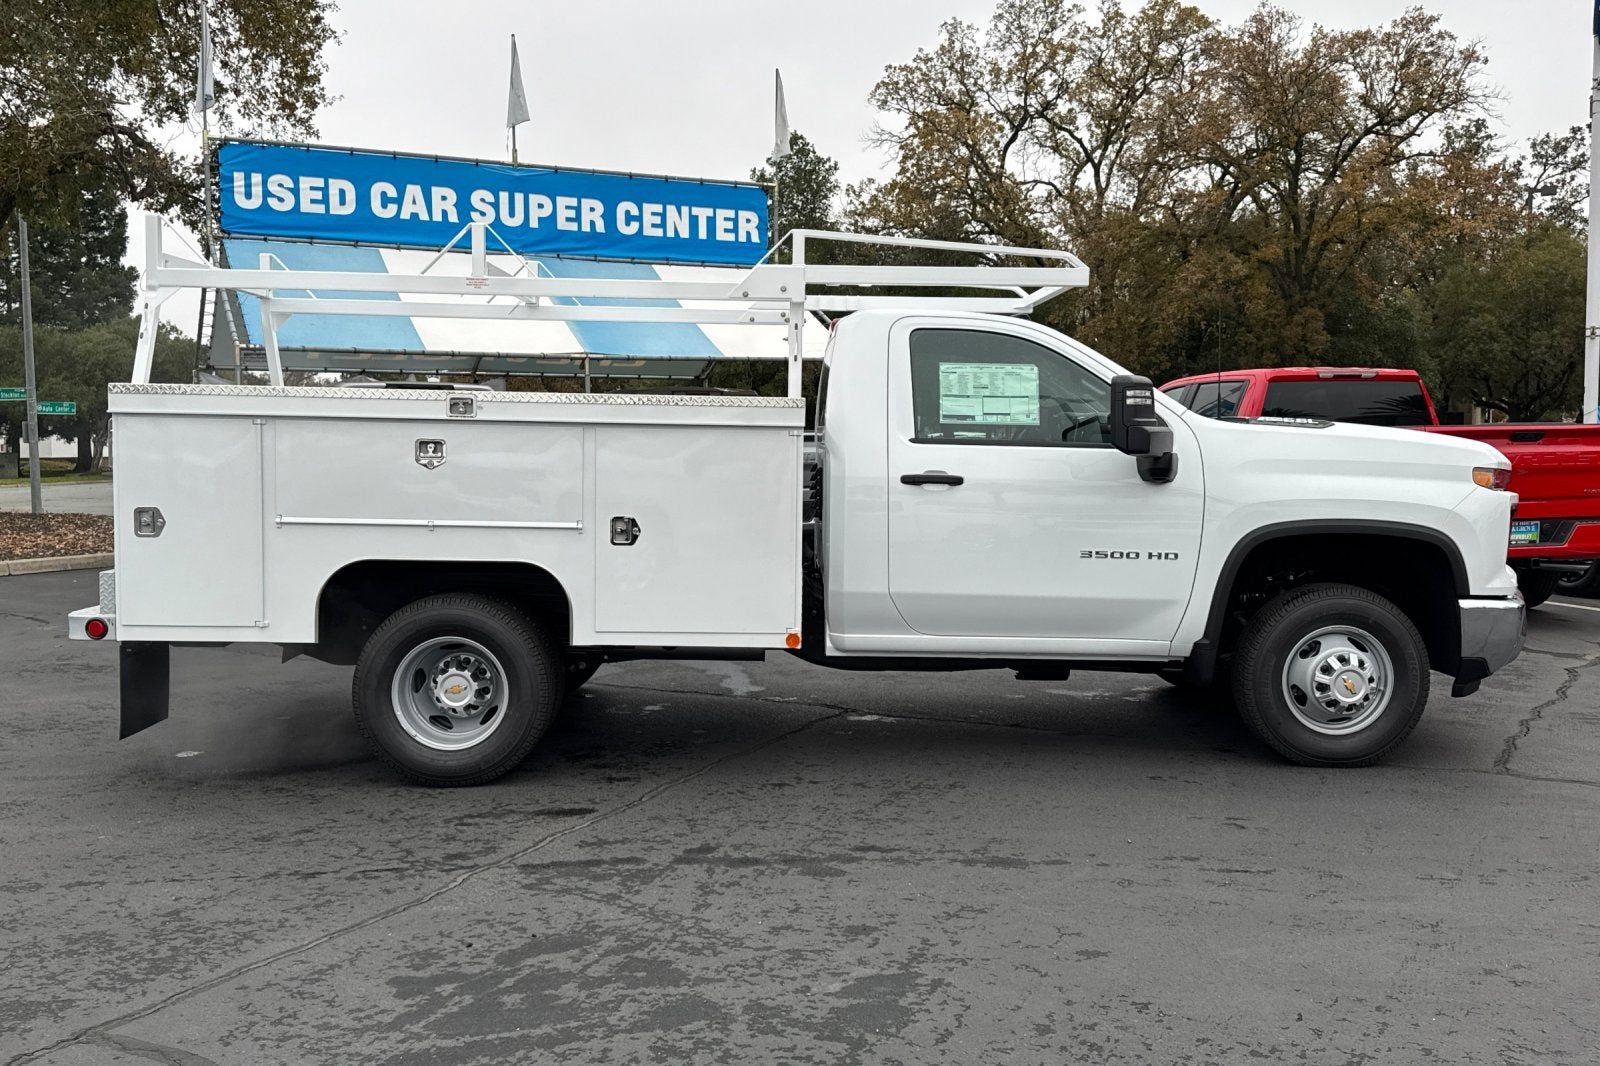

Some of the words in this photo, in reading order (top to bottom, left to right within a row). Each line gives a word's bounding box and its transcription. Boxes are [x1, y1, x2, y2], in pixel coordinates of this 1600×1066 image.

[233, 171, 356, 216] USED
[370, 181, 460, 224] CAR
[470, 189, 606, 233] SUPER
[616, 201, 761, 243] CENTER
[1079, 550, 1140, 560] 3500
[1147, 551, 1179, 560] HD
